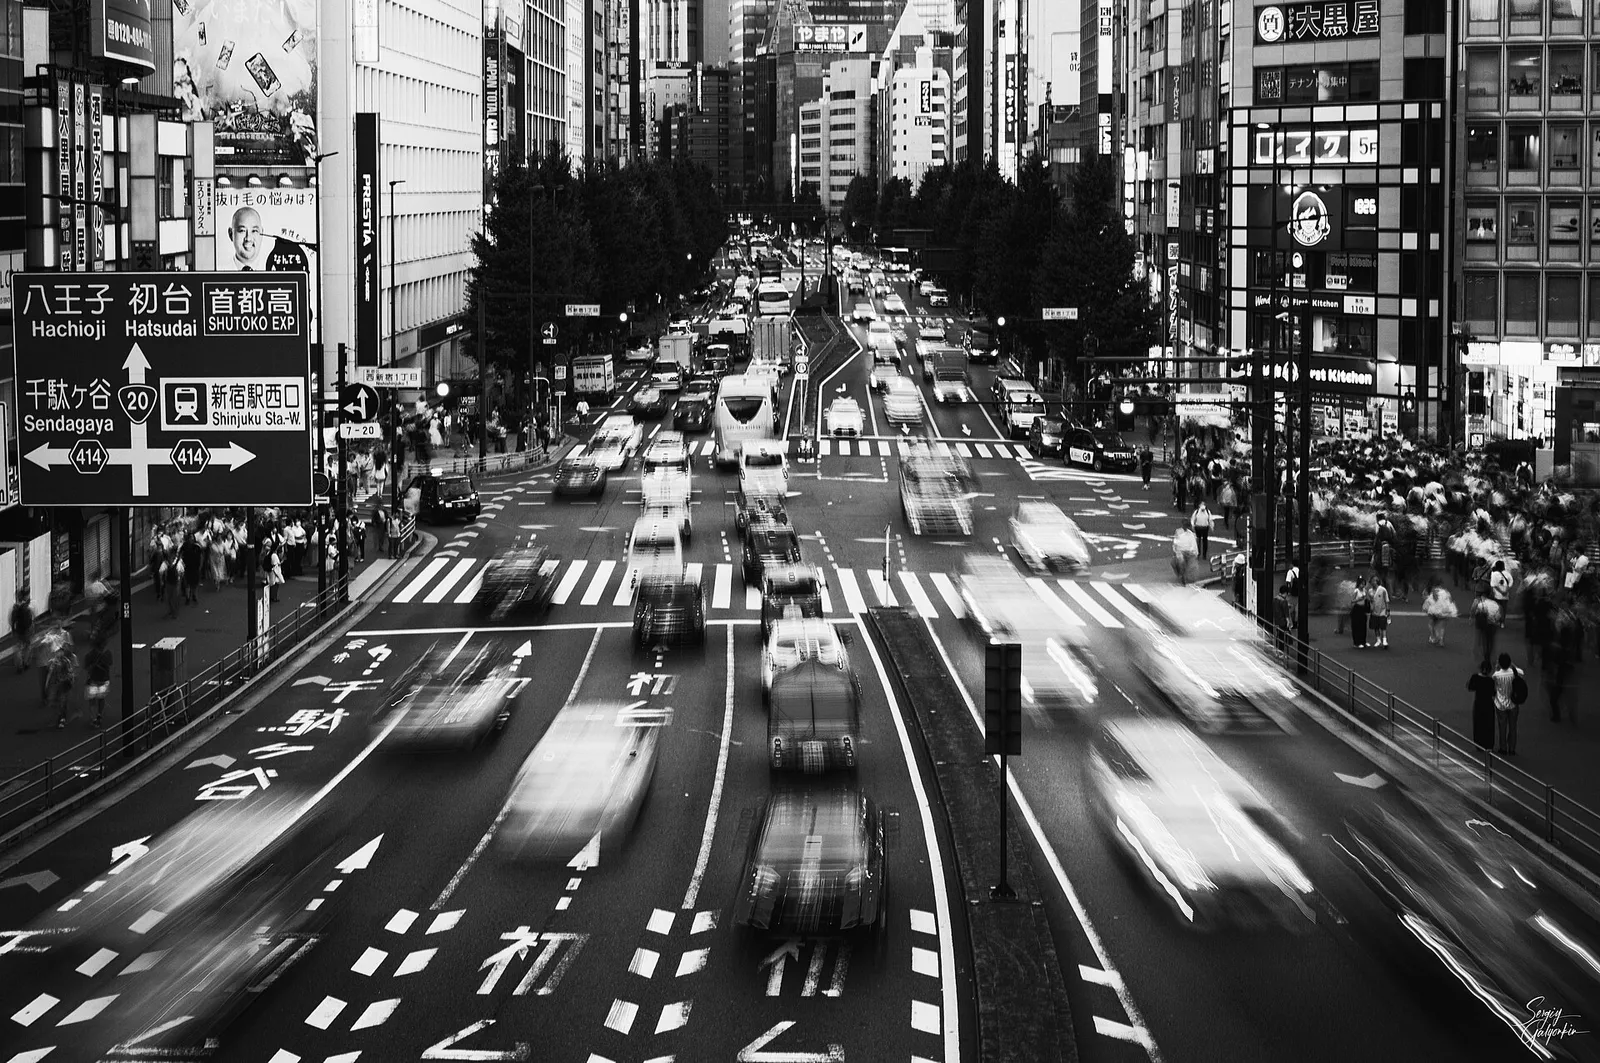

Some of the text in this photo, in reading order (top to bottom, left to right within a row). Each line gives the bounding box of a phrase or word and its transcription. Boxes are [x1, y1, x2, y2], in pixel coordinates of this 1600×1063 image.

[1296, 1, 1378, 38] 大黒屋
[798, 26, 845, 42] やまや
[486, 57, 498, 89] JAPAN
[486, 90, 498, 118] TOTAL
[1359, 136, 1378, 155] 5F
[75, 134, 85, 266] 大黒屋
[216, 191, 315, 207] 抜け毛の悩みは？
[273, 255, 302, 265] なんでも
[23, 284, 114, 315] 八王子
[128, 282, 193, 315] 初台
[209, 287, 294, 315] 首都高
[1312, 299, 1339, 308] Kitchen
[32, 320, 106, 340] Hachioji
[125, 320, 197, 337] Hatsudai
[208, 316, 295, 331] SHUTOKO EXP
[1328, 368, 1373, 386] Kitchen
[25, 378, 112, 410] 千駄ヶ谷
[127, 391, 149, 411] 20
[211, 383, 300, 409] 新宿駅西口
[24, 415, 114, 434] Sendagaya
[212, 411, 301, 428] Shinjuku Sta.-W.
[76, 448, 102, 465] 414
[177, 448, 204, 465] 414
